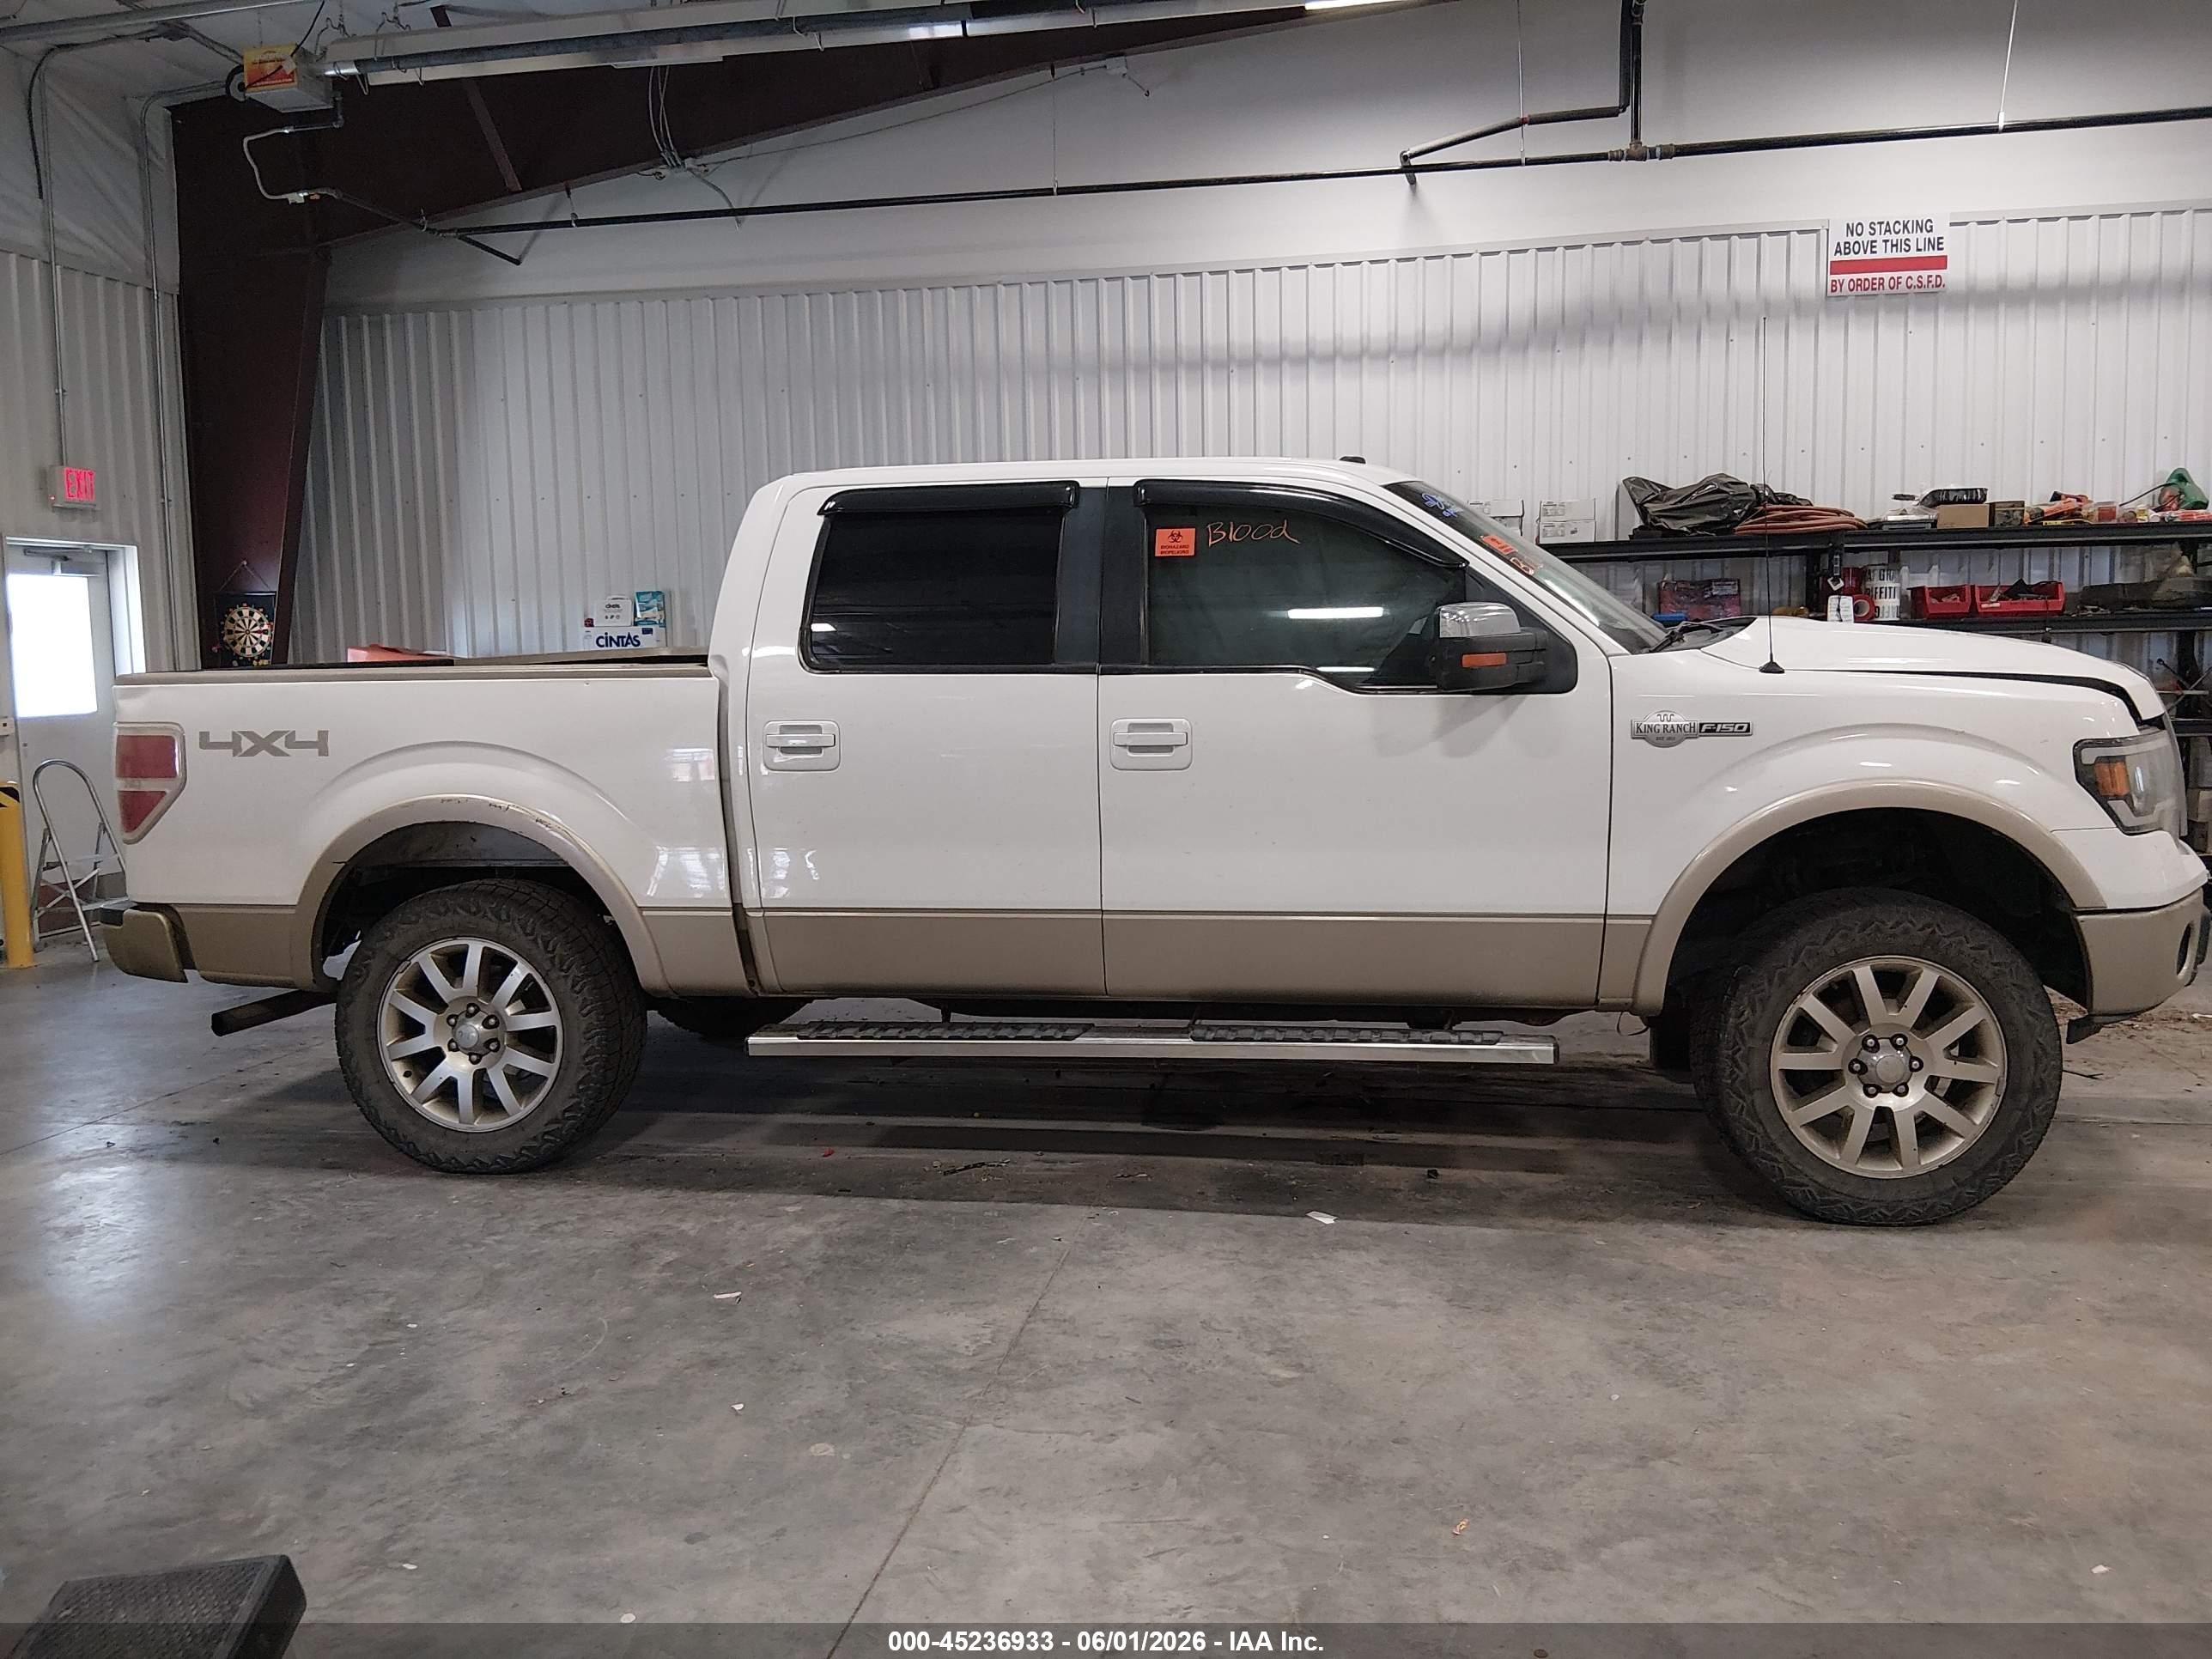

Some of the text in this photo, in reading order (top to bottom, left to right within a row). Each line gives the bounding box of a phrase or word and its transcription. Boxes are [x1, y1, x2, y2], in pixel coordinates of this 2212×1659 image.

[1846, 218, 1934, 237] NO STACKING
[1834, 236, 1945, 256] ABOVE THIS LINE
[1831, 275, 1946, 293] BY ORDER OF C.S.F.D.
[64, 467, 96, 501] EXIT
[1206, 520, 1301, 547] Blood
[1636, 721, 1748, 734] KING RANCH F-150
[199, 730, 329, 757] 4X4
